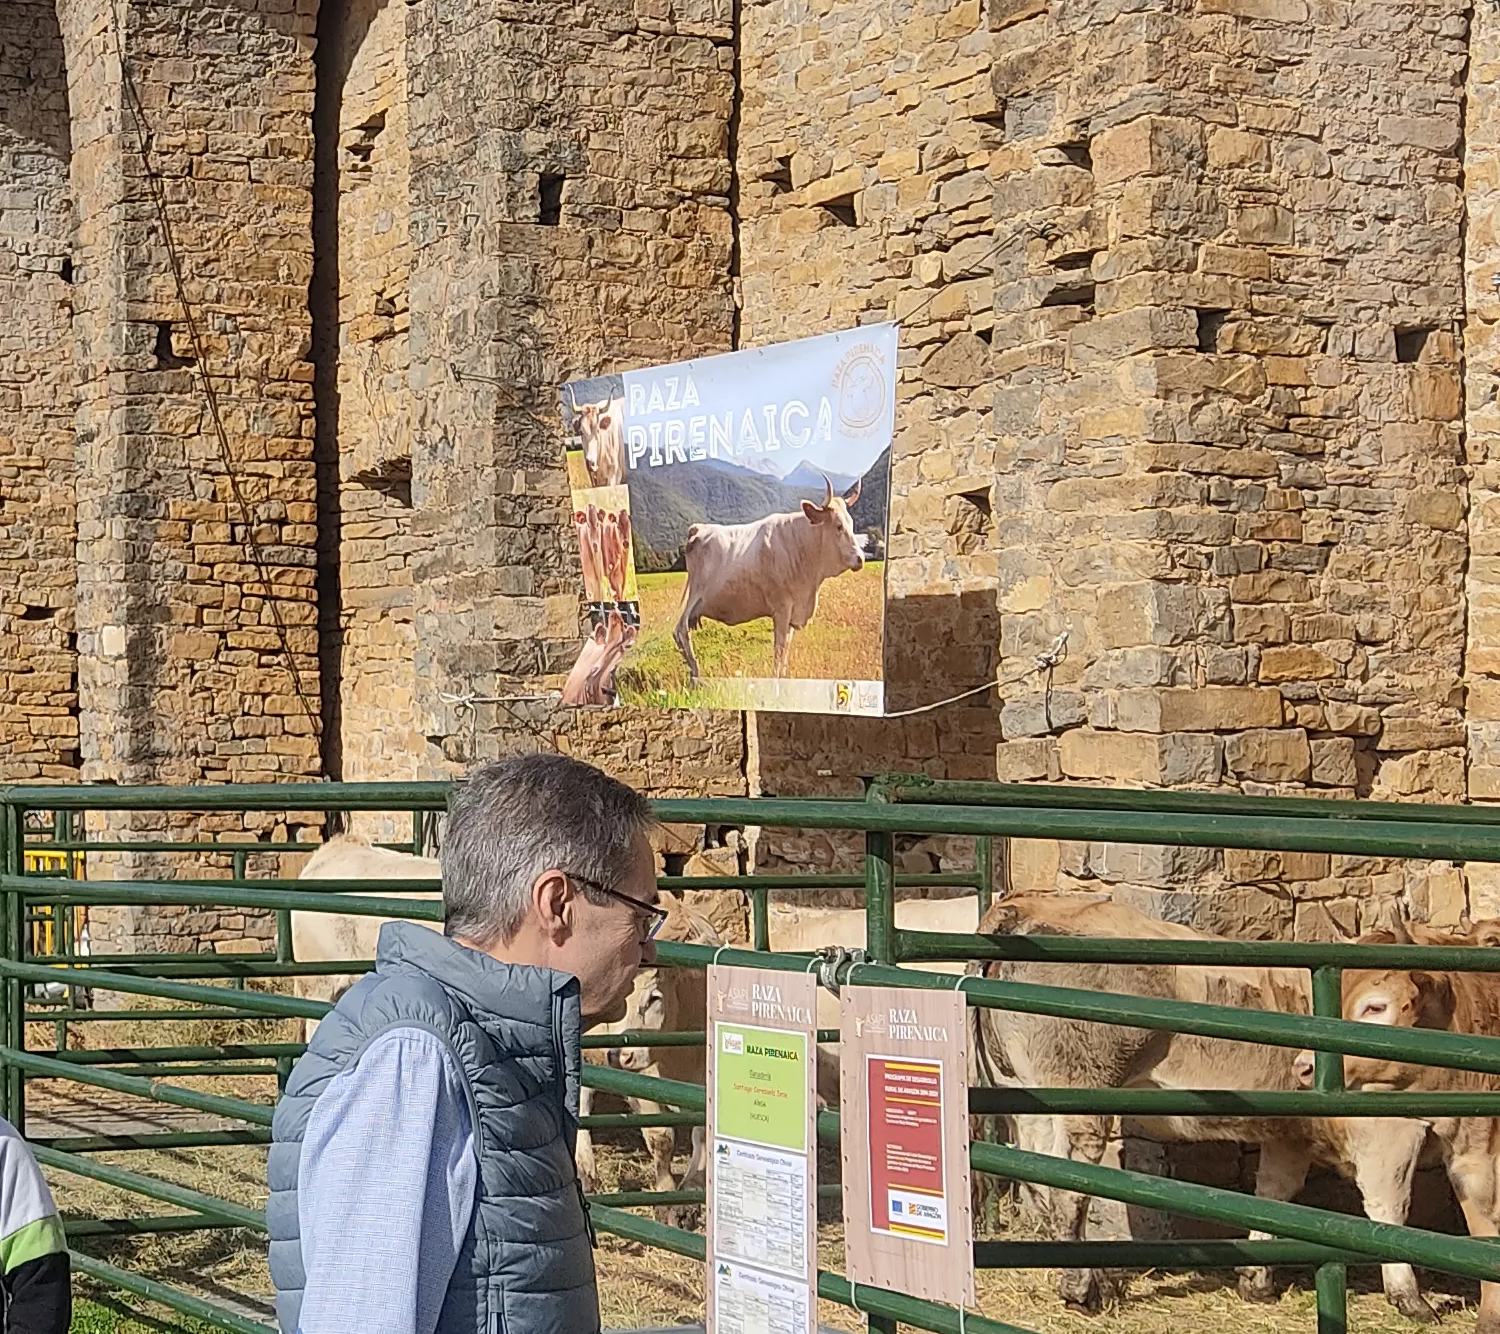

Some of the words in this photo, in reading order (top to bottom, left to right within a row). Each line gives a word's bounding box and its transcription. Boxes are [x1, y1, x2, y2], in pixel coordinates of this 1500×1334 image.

[629, 374, 701, 417] RAZA
[627, 395, 833, 470] PIRENAICA
[752, 983, 782, 1003] RAZA
[751, 1001, 813, 1025] PIRENAICA
[889, 1008, 918, 1024] RAZA
[888, 1024, 949, 1043] PIRENAICA
[746, 1045, 764, 1056] RAZA
[764, 1047, 799, 1062] PIRENAICA
